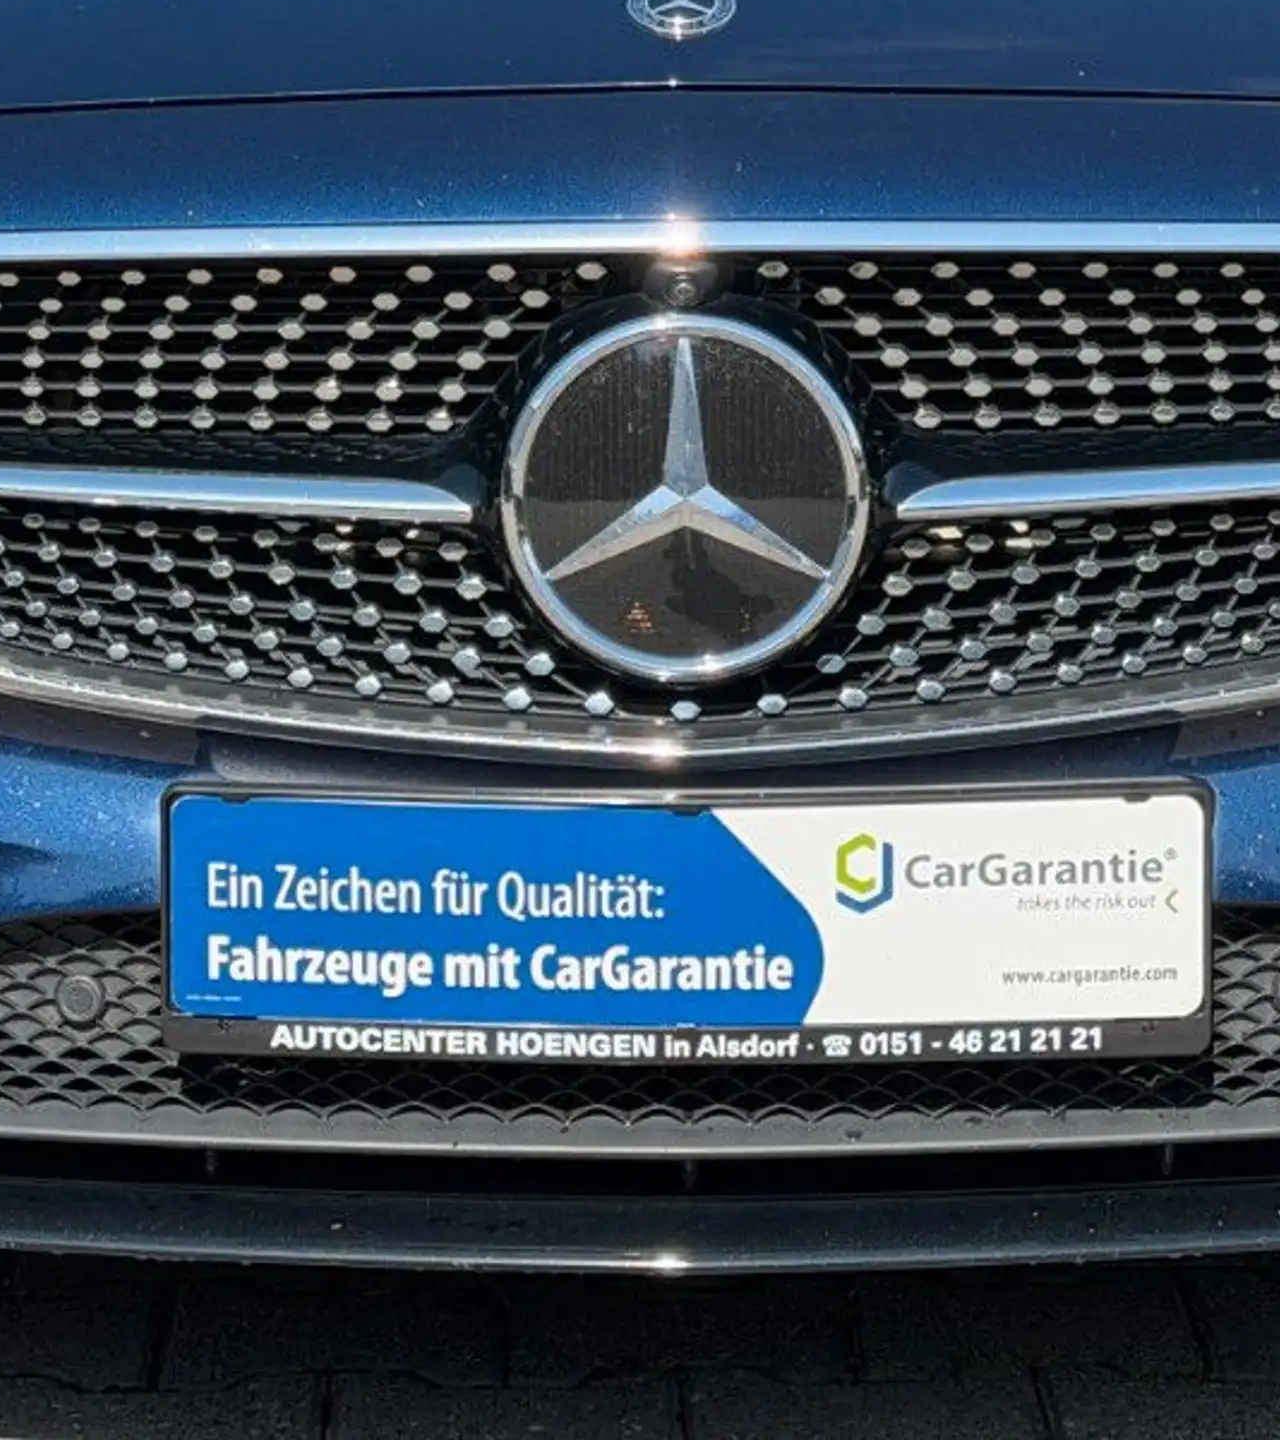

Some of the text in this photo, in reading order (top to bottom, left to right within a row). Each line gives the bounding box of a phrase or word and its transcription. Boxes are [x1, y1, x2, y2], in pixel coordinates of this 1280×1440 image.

[207, 861, 665, 922] Ein Zeichen für Qualität:
[1064, 893, 1091, 911] the
[1095, 893, 1125, 910] risk
[1127, 894, 1156, 910] out
[207, 933, 795, 998] Fahrzeuge mit CarGarantie
[1001, 964, 1178, 987] www.cargarantie.com
[269, 1024, 487, 1056] AUTOCENTER
[496, 1028, 656, 1058] HOENGEN
[664, 1036, 691, 1058] in
[696, 1032, 800, 1059] Alsdorf
[859, 1030, 923, 1055] 0151
[948, 1029, 982, 1053] 46
[988, 1028, 1021, 1052] 21
[1029, 1027, 1061, 1052] 21
[1070, 1025, 1102, 1051] 21
